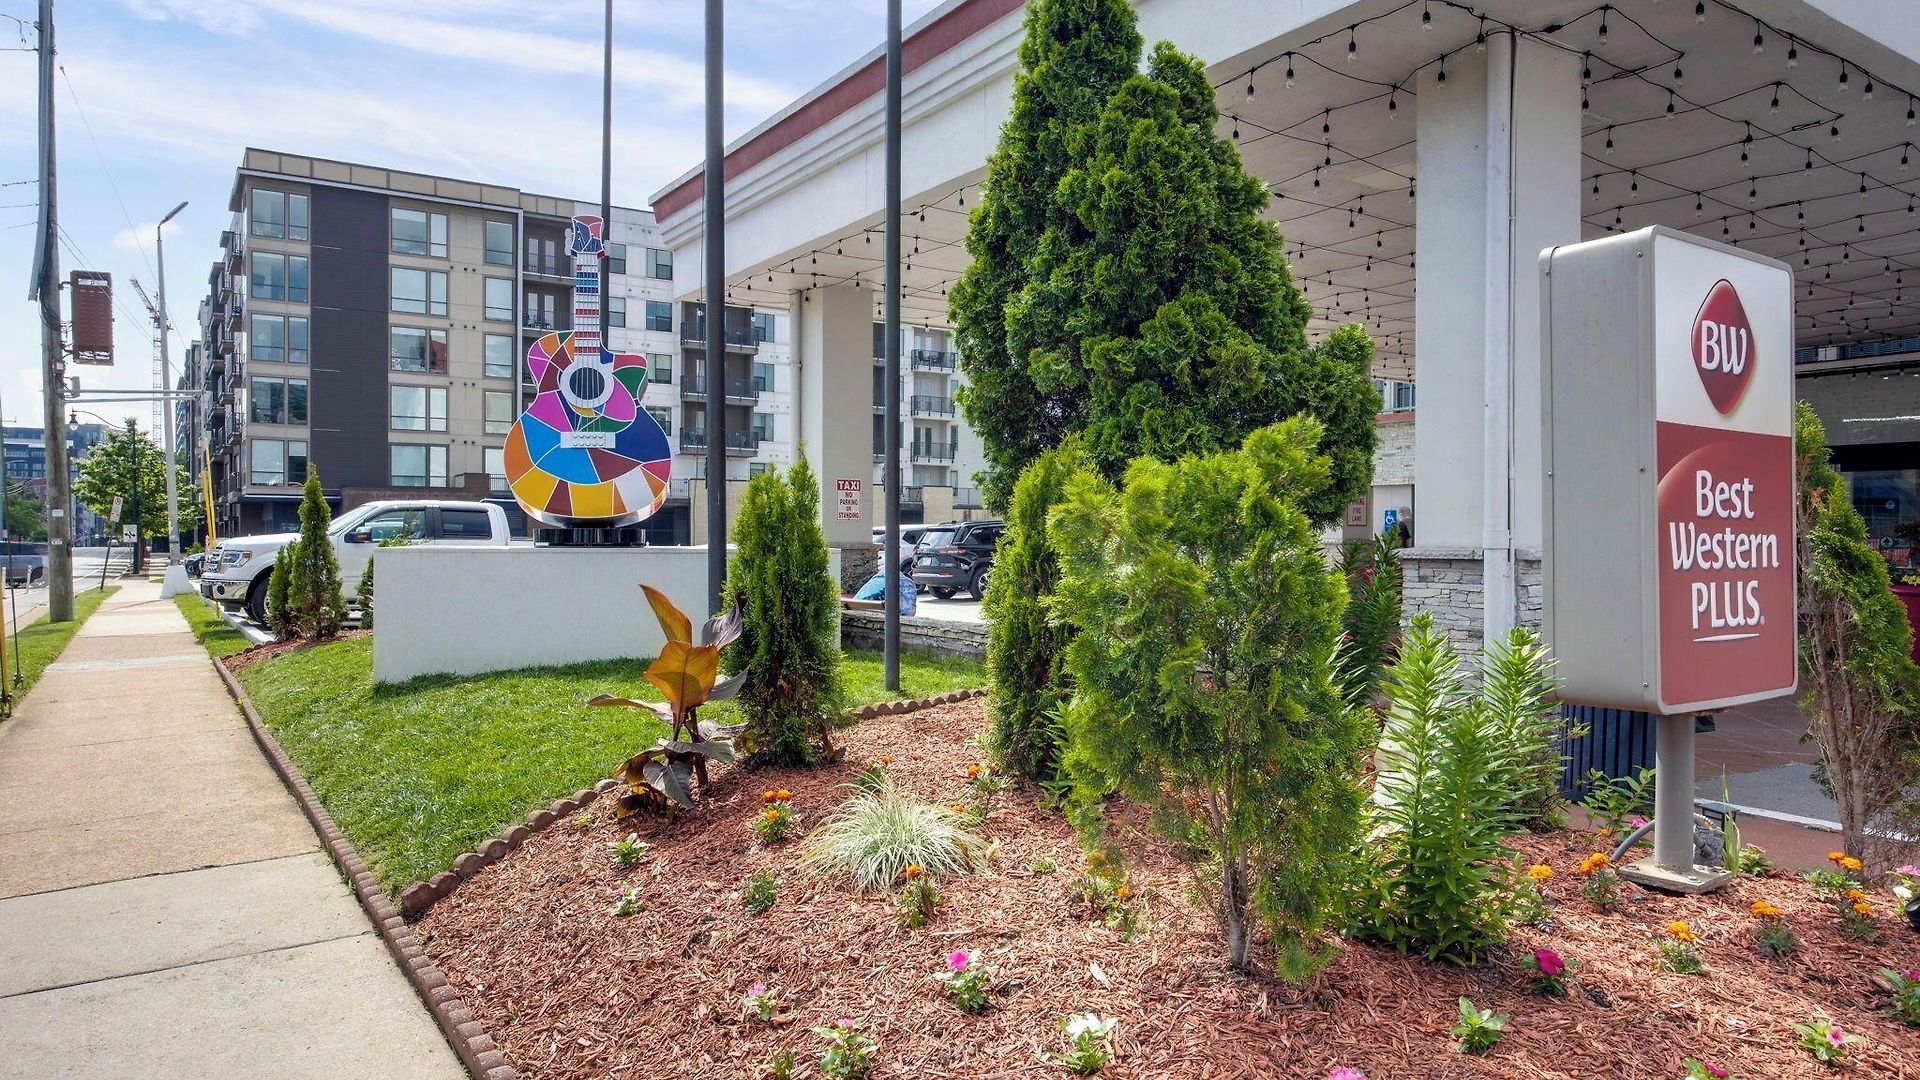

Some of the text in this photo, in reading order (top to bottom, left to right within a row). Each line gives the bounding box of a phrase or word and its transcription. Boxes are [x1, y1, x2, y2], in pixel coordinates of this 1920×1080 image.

[1701, 319, 1747, 375] BW
[838, 481, 860, 490] TAXI
[1696, 469, 1755, 519] Best
[1669, 521, 1780, 570] Western
